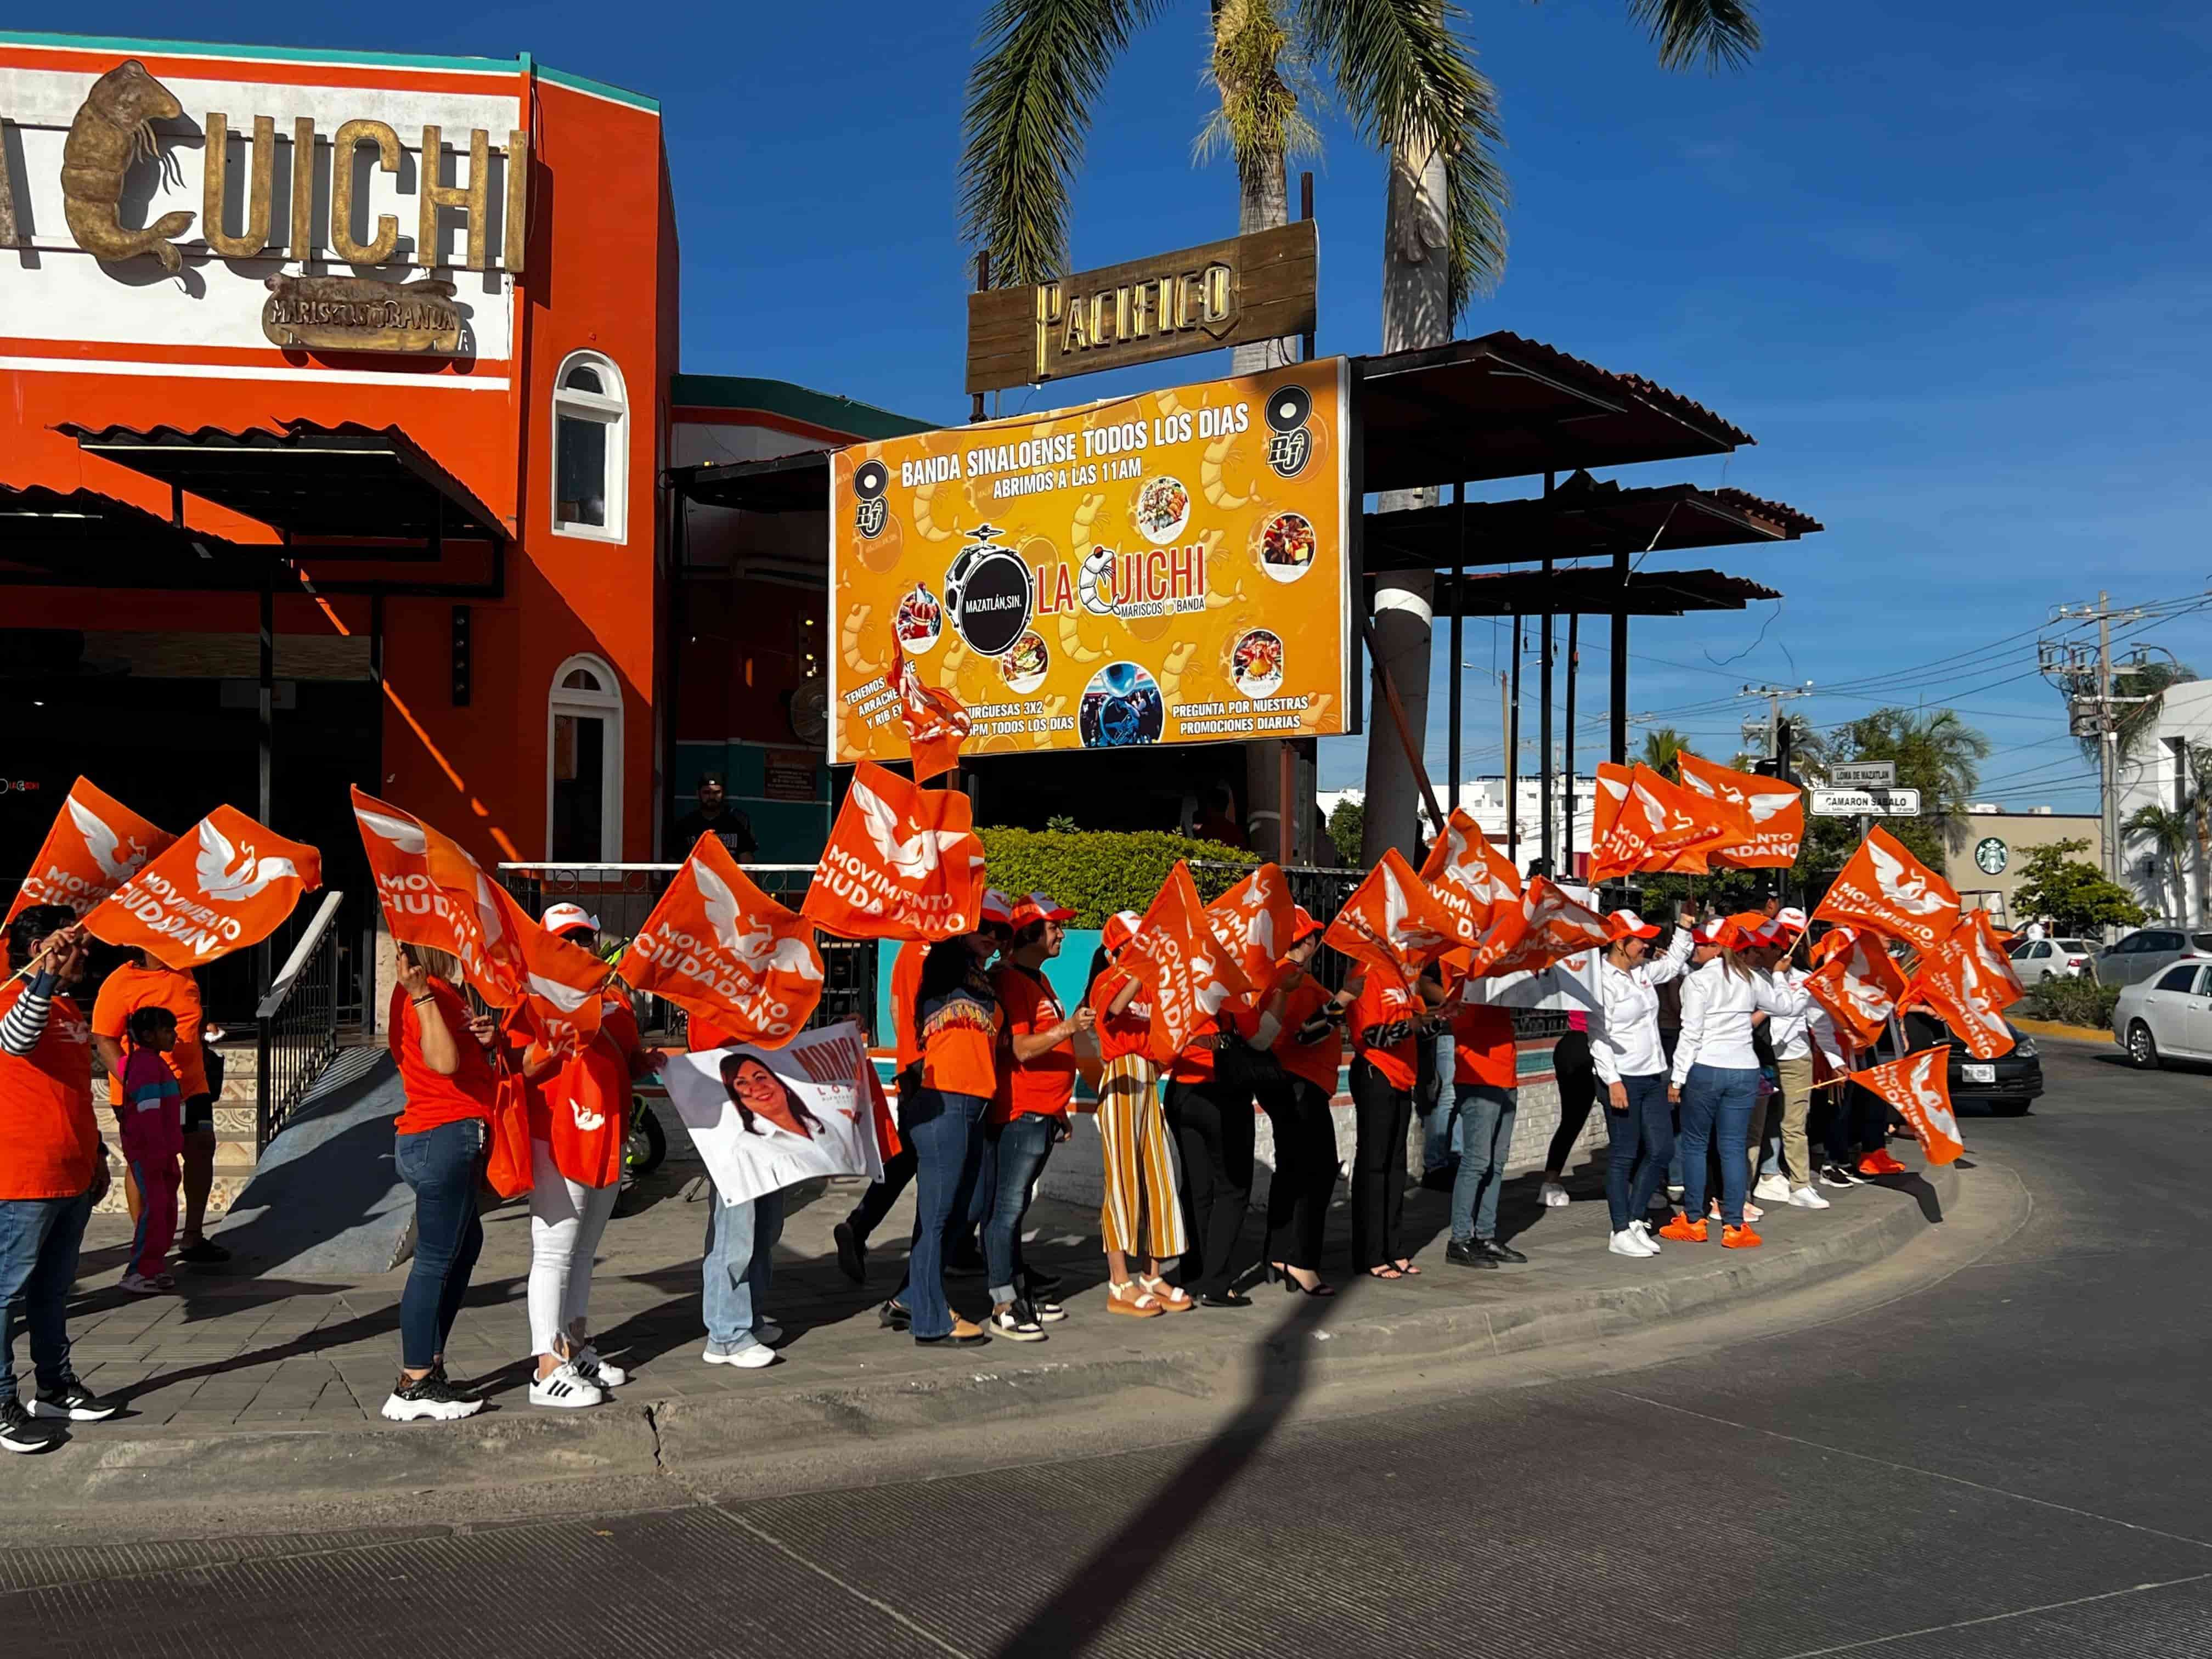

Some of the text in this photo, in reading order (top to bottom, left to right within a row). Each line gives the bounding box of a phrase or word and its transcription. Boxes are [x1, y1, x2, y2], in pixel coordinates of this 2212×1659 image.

[1036, 266, 1231, 379] PACIFICO
[901, 403, 1249, 487] BANDA SINALOENSE TODOS LOS DIAS
[993, 471, 1054, 499] ABRIMOS
[1058, 469, 1068, 489] A
[1071, 465, 1097, 487] LAS
[1102, 457, 1142, 482] 11AM
[1038, 563, 1074, 614] LA
[1121, 597, 1205, 618] MARISCOS BANDA
[844, 676, 885, 706] TENEMOS
[858, 689, 900, 718] ARRACHE
[866, 702, 902, 730] Y RIB EY
[966, 701, 1044, 720] URGUESAS 3X2
[1172, 695, 1309, 718] PREGUNTA POR NUESTRAS
[991, 720, 1025, 734] TODOS
[1028, 718, 1047, 732] LOS
[1049, 716, 1075, 730] DIAS
[1180, 715, 1301, 735] PROMOCIONES DIARIAS
[1853, 771, 1860, 780] DE
[1826, 797, 1868, 806] CAMARON
[633, 933, 792, 1035] CIUDADANO
[657, 922, 789, 1018] MOVIMIENTO
